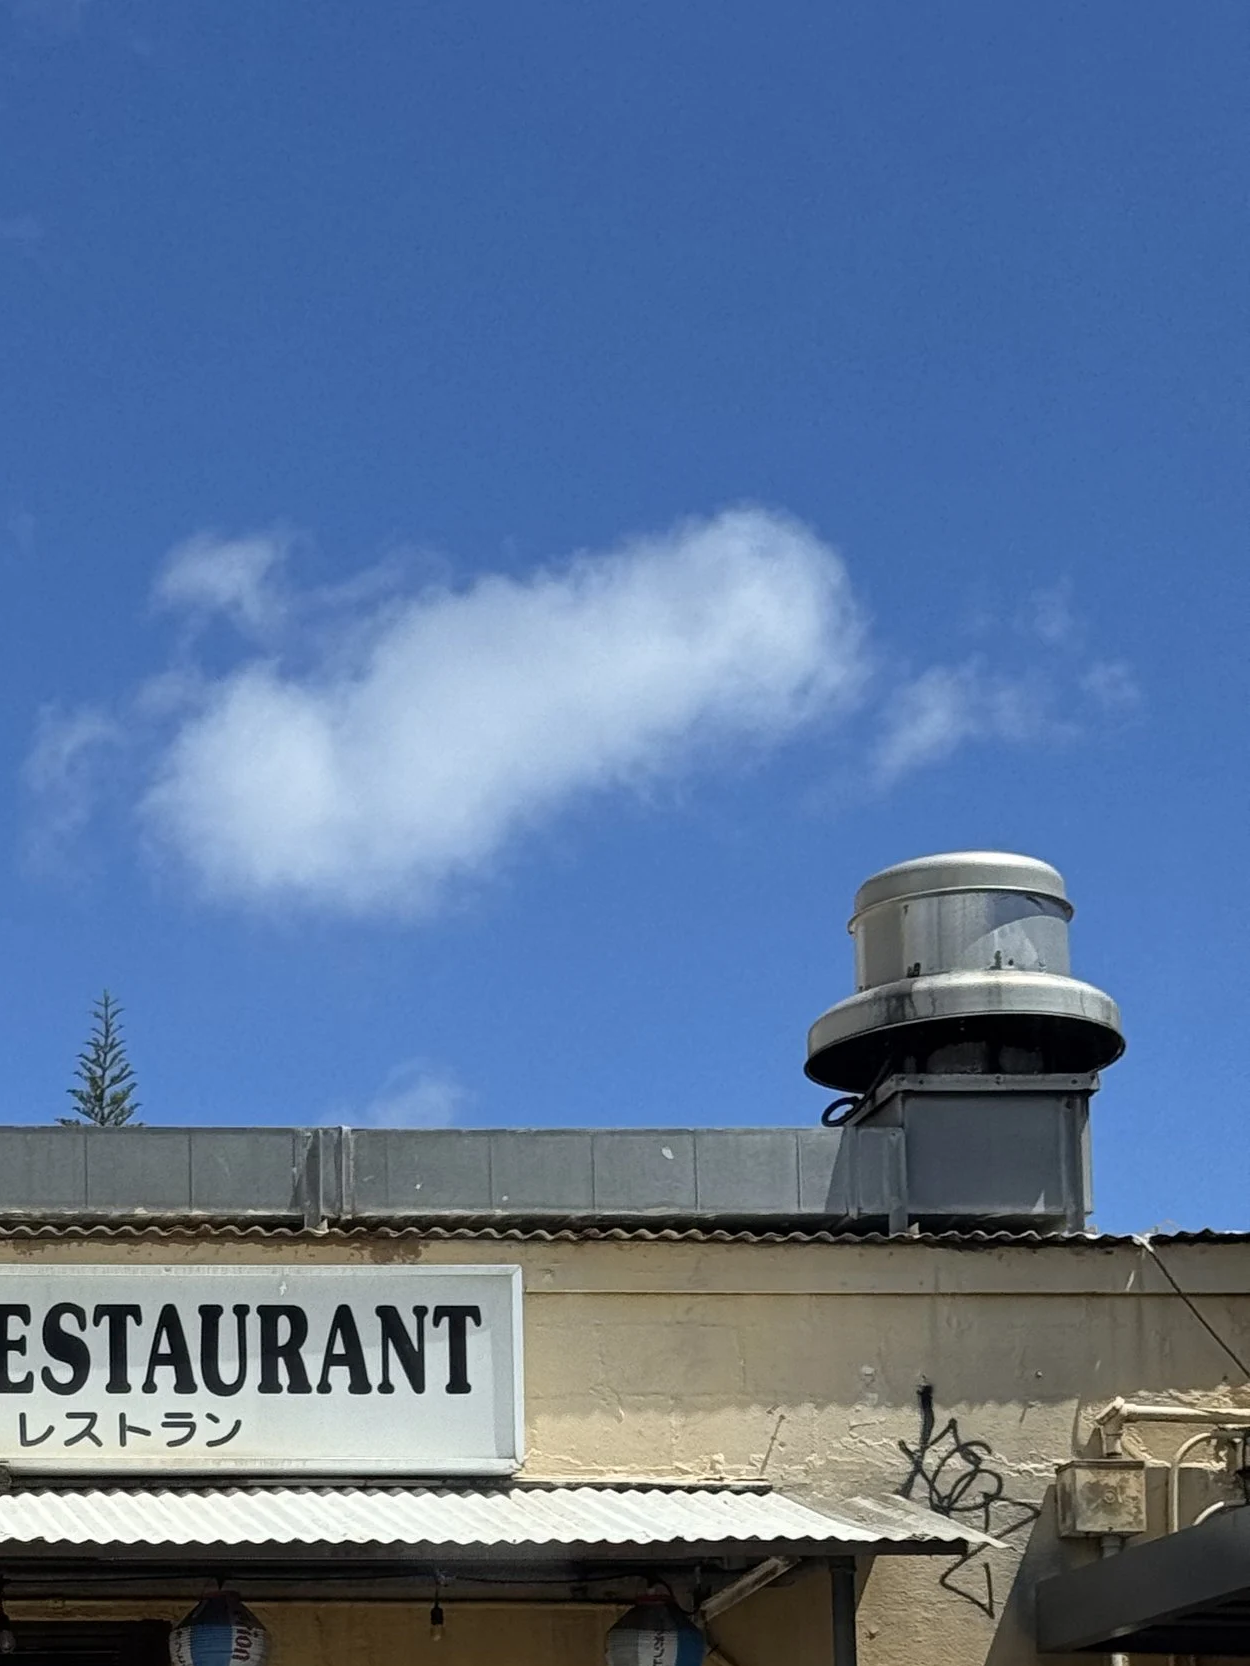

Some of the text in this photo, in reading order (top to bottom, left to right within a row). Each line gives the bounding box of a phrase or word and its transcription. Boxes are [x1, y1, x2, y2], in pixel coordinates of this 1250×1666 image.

[19, 1411, 243, 1449] レストラン
